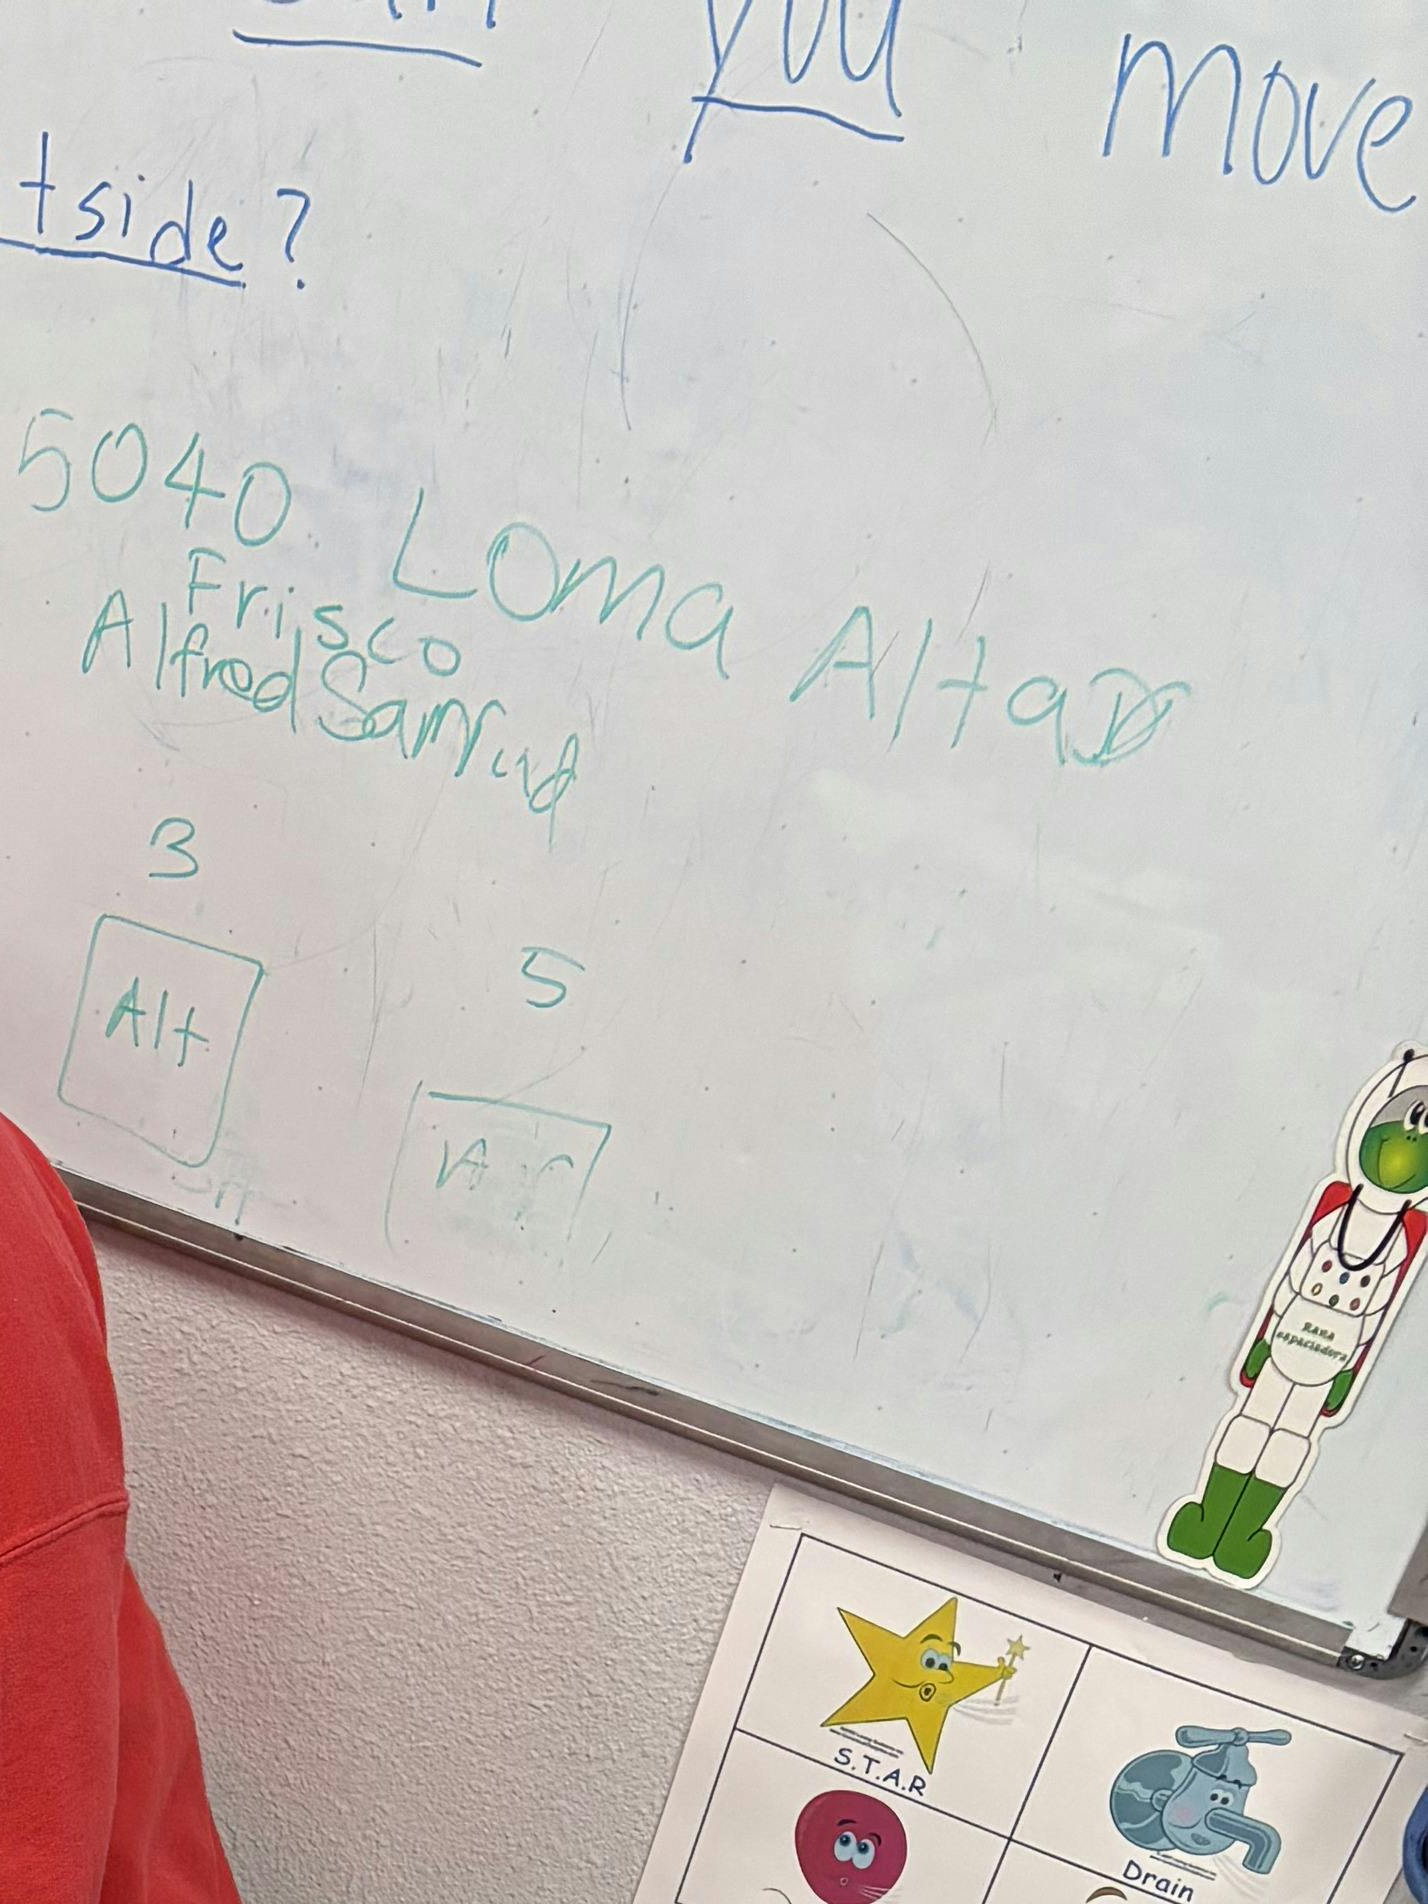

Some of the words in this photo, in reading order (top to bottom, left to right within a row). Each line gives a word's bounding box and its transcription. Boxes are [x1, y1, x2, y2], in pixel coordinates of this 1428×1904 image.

[1104, 34, 1418, 212] move
[18, 408, 292, 547] 5040
[188, 547, 462, 677] Frisco
[81, 590, 302, 734] Alfred
[148, 817, 199, 878] 3
[520, 946, 586, 1008] 5
[104, 975, 210, 1067] Alt
[1301, 1321, 1336, 1342] Rana
[833, 1747, 928, 1797] S.T.A.R
[1123, 1859, 1195, 1902] Drain
